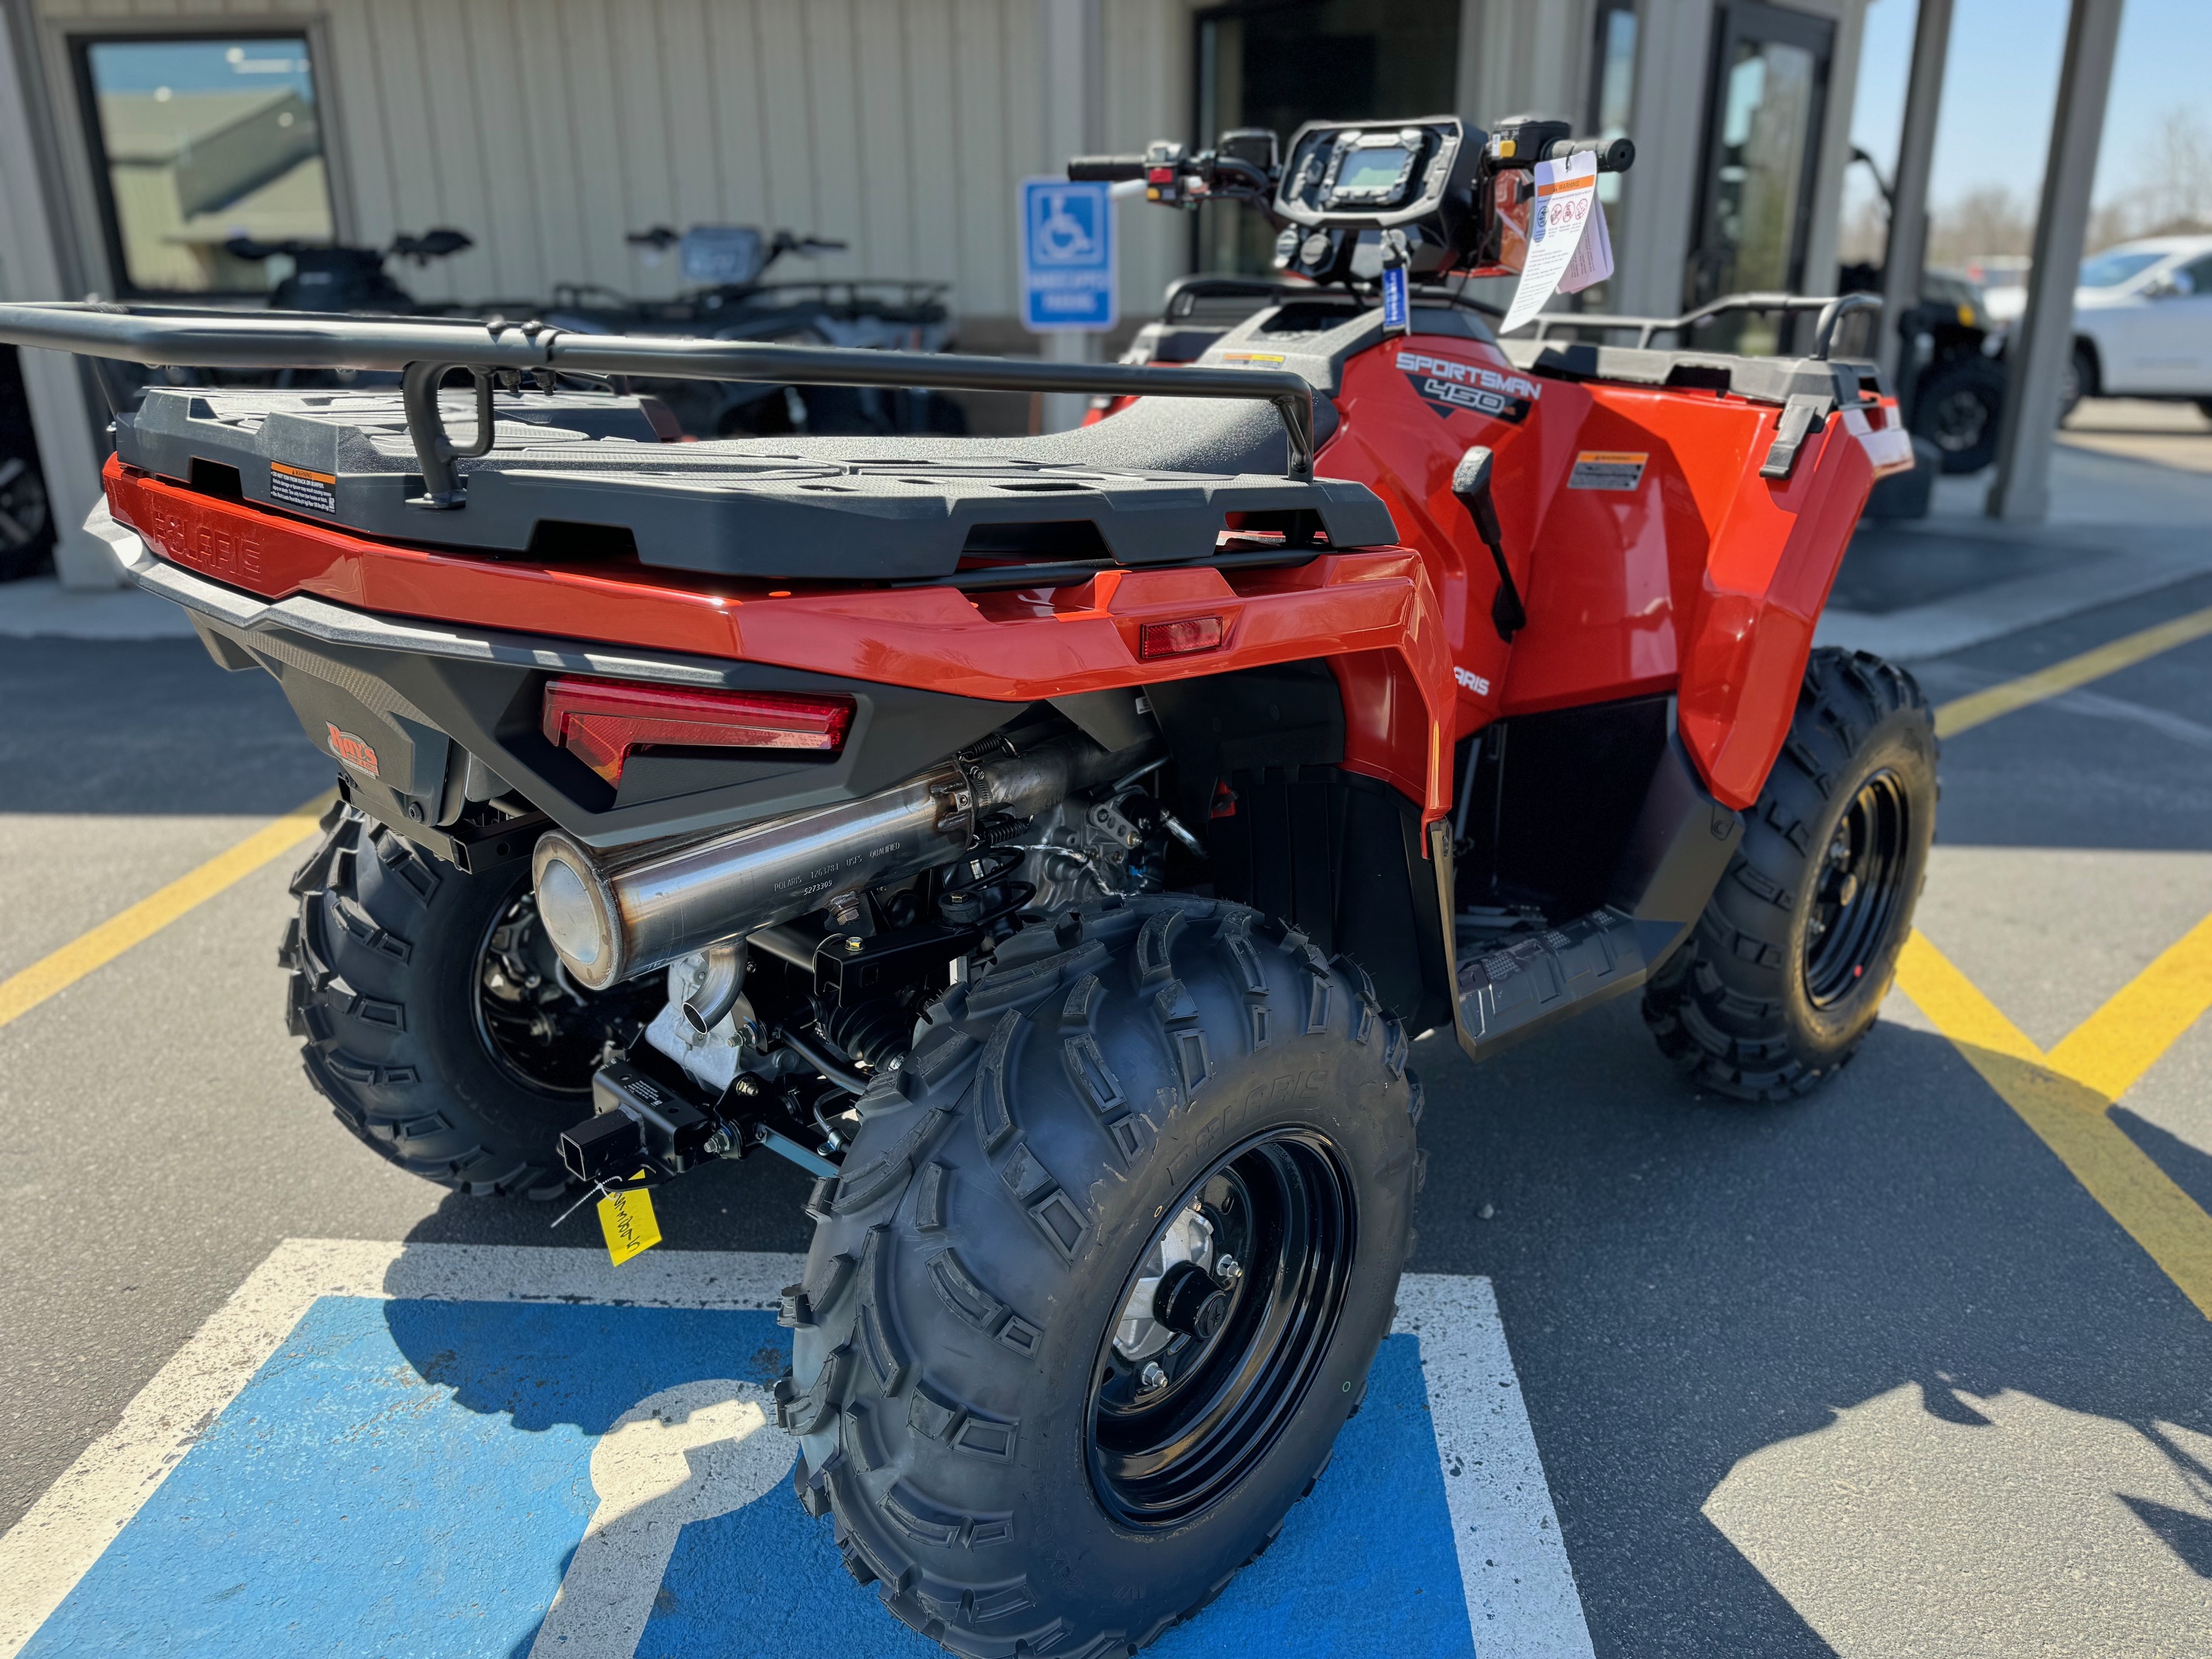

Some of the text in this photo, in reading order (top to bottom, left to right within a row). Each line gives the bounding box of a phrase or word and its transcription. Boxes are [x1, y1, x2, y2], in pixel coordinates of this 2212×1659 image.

[1558, 180, 1580, 191] WARNING
[1396, 352, 1543, 400] SPORTSMAN
[1424, 378, 1505, 414] 450
[774, 875, 802, 891] POLARIS
[846, 854, 863, 867] USFS
[869, 841, 901, 858] QUALIFIED
[803, 879, 833, 895] 5273309
